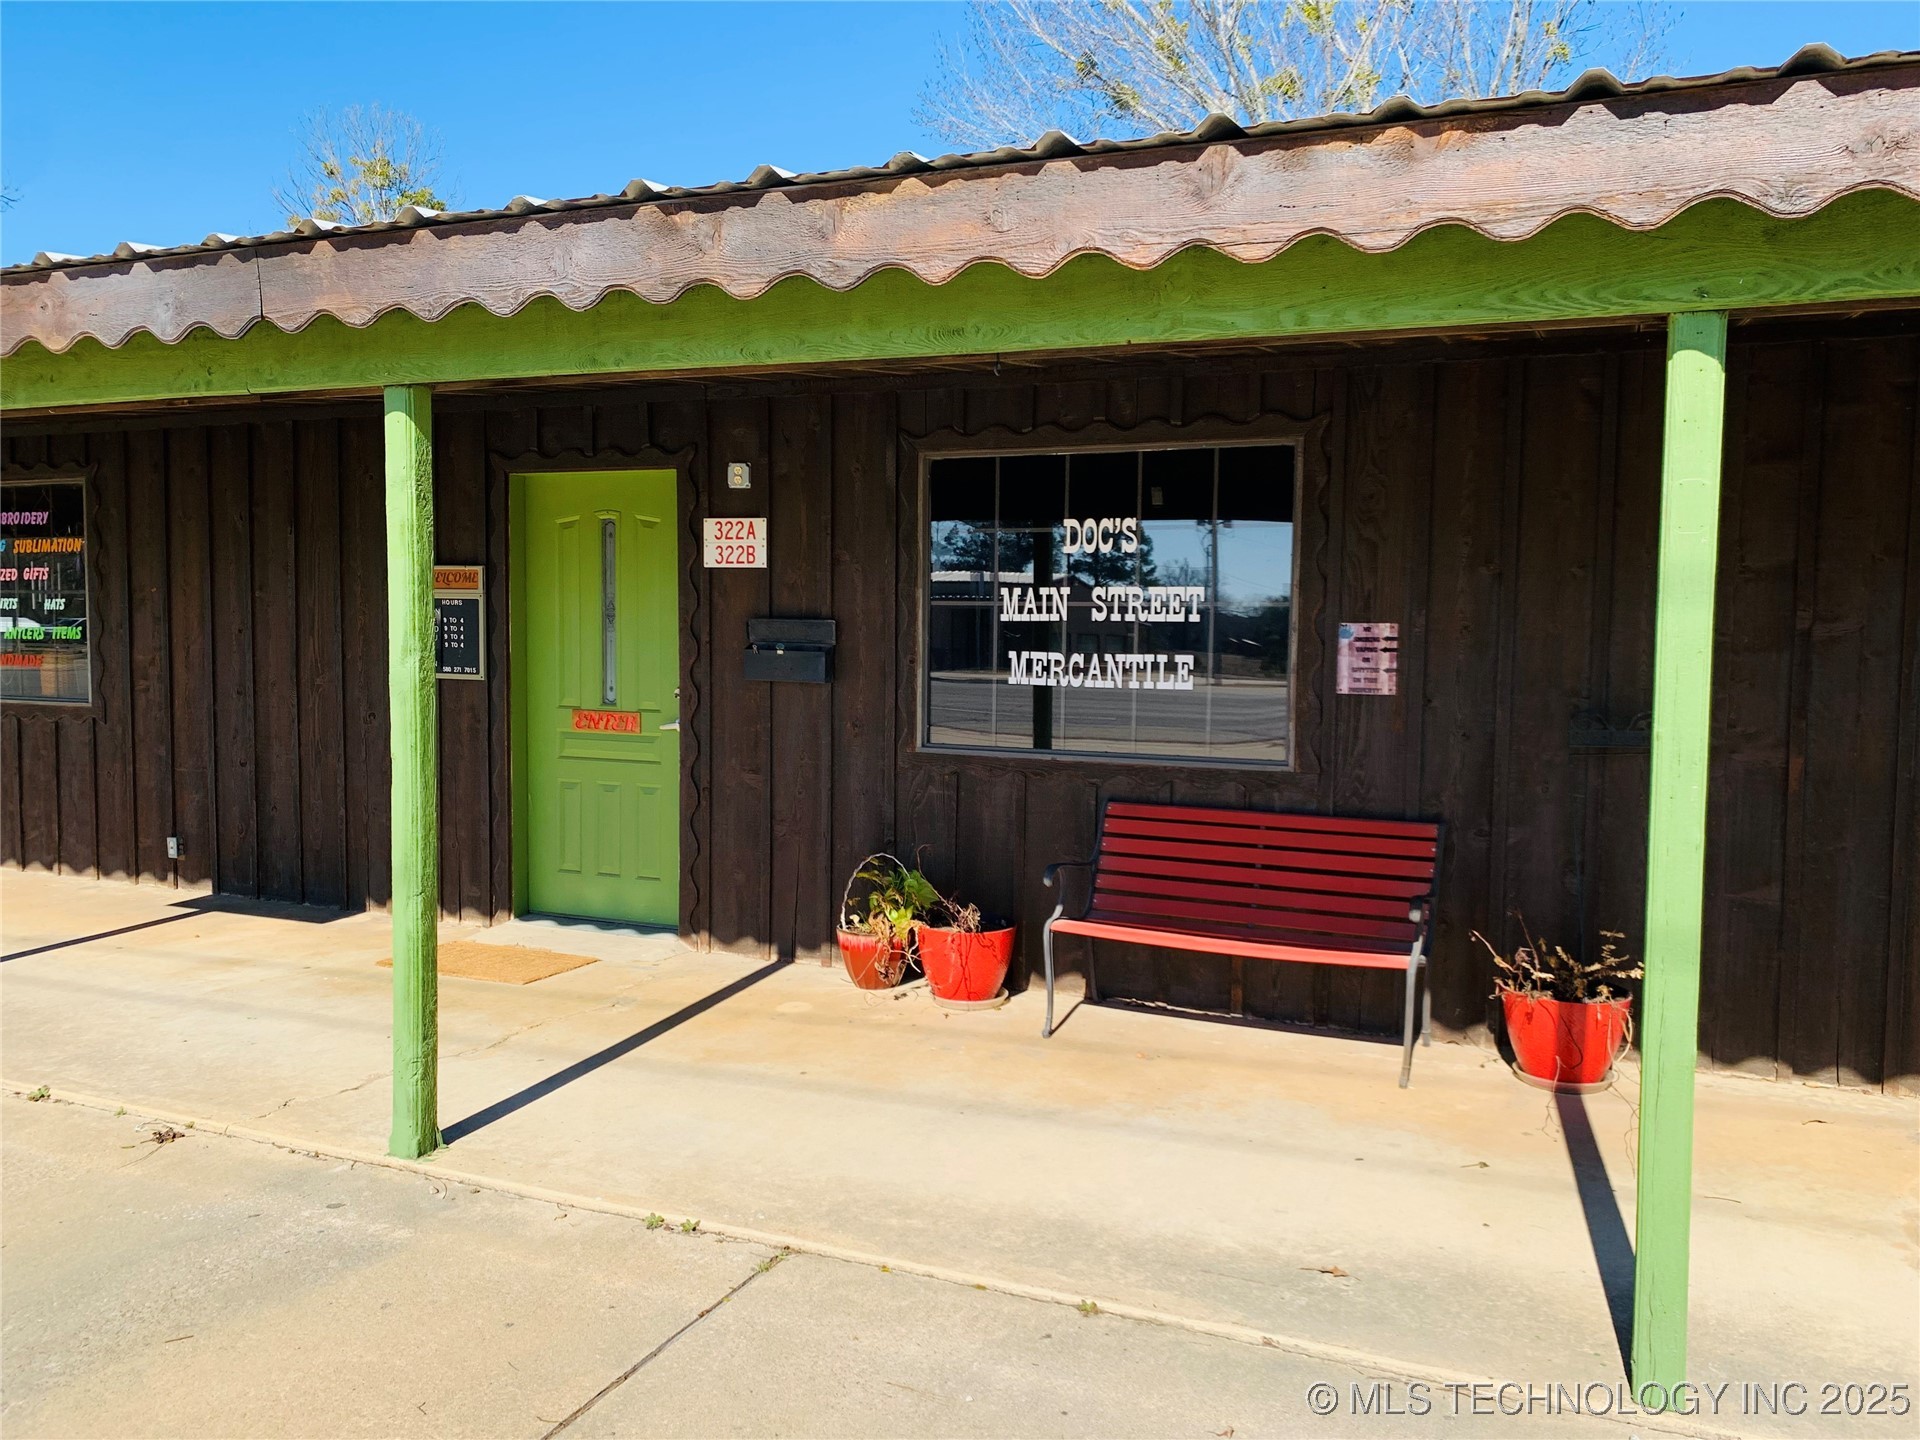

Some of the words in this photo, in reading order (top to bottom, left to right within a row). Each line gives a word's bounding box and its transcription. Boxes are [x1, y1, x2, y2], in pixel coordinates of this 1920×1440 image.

[0, 511, 49, 526] BROIDERY
[714, 520, 756, 541] 322A
[1063, 517, 1138, 554] DOC'S
[13, 538, 82, 554] SUBLIMATION
[715, 544, 756, 565] 322B
[23, 567, 49, 580] GIFTS
[434, 571, 479, 586] ELCOME
[44, 598, 66, 610] HATS
[1000, 587, 1071, 622] MAIN
[1091, 586, 1205, 622] STREET
[4, 626, 45, 640] ANTLERS
[52, 626, 82, 640] ITEMS
[1008, 650, 1194, 690] MERCANTILE
[575, 711, 637, 732] ENTER
